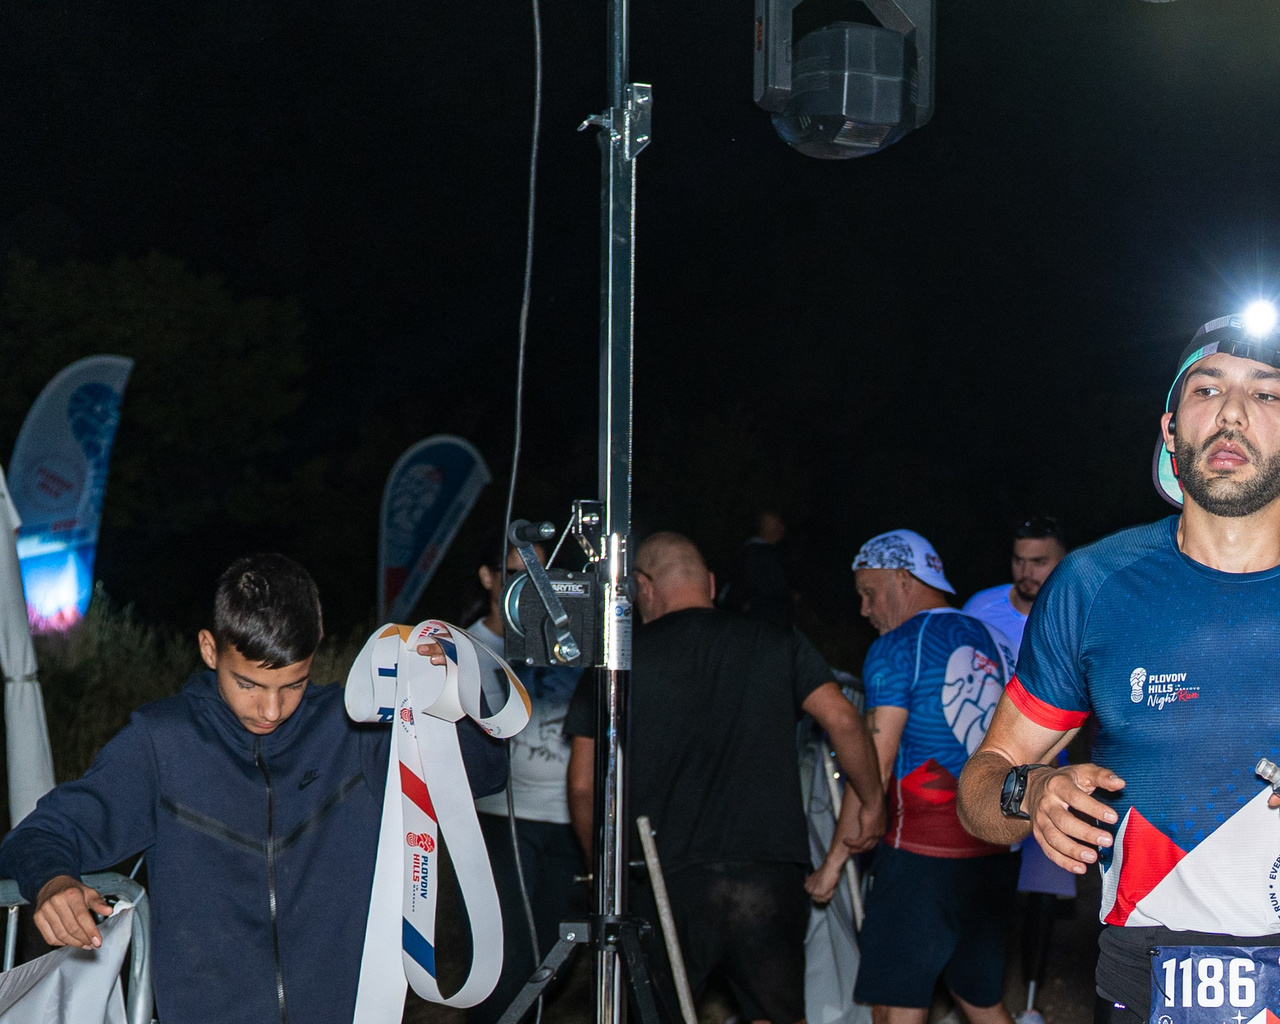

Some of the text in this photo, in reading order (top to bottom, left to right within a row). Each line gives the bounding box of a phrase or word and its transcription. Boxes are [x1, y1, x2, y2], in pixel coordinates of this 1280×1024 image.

[1148, 684, 1173, 694] HILLS
[1149, 673, 1187, 684] PLOVDIV
[1147, 689, 1199, 710] Night Run
[412, 853, 421, 882] HILLS
[420, 855, 429, 899] PLOVDIV
[1162, 957, 1256, 1008] 1186
